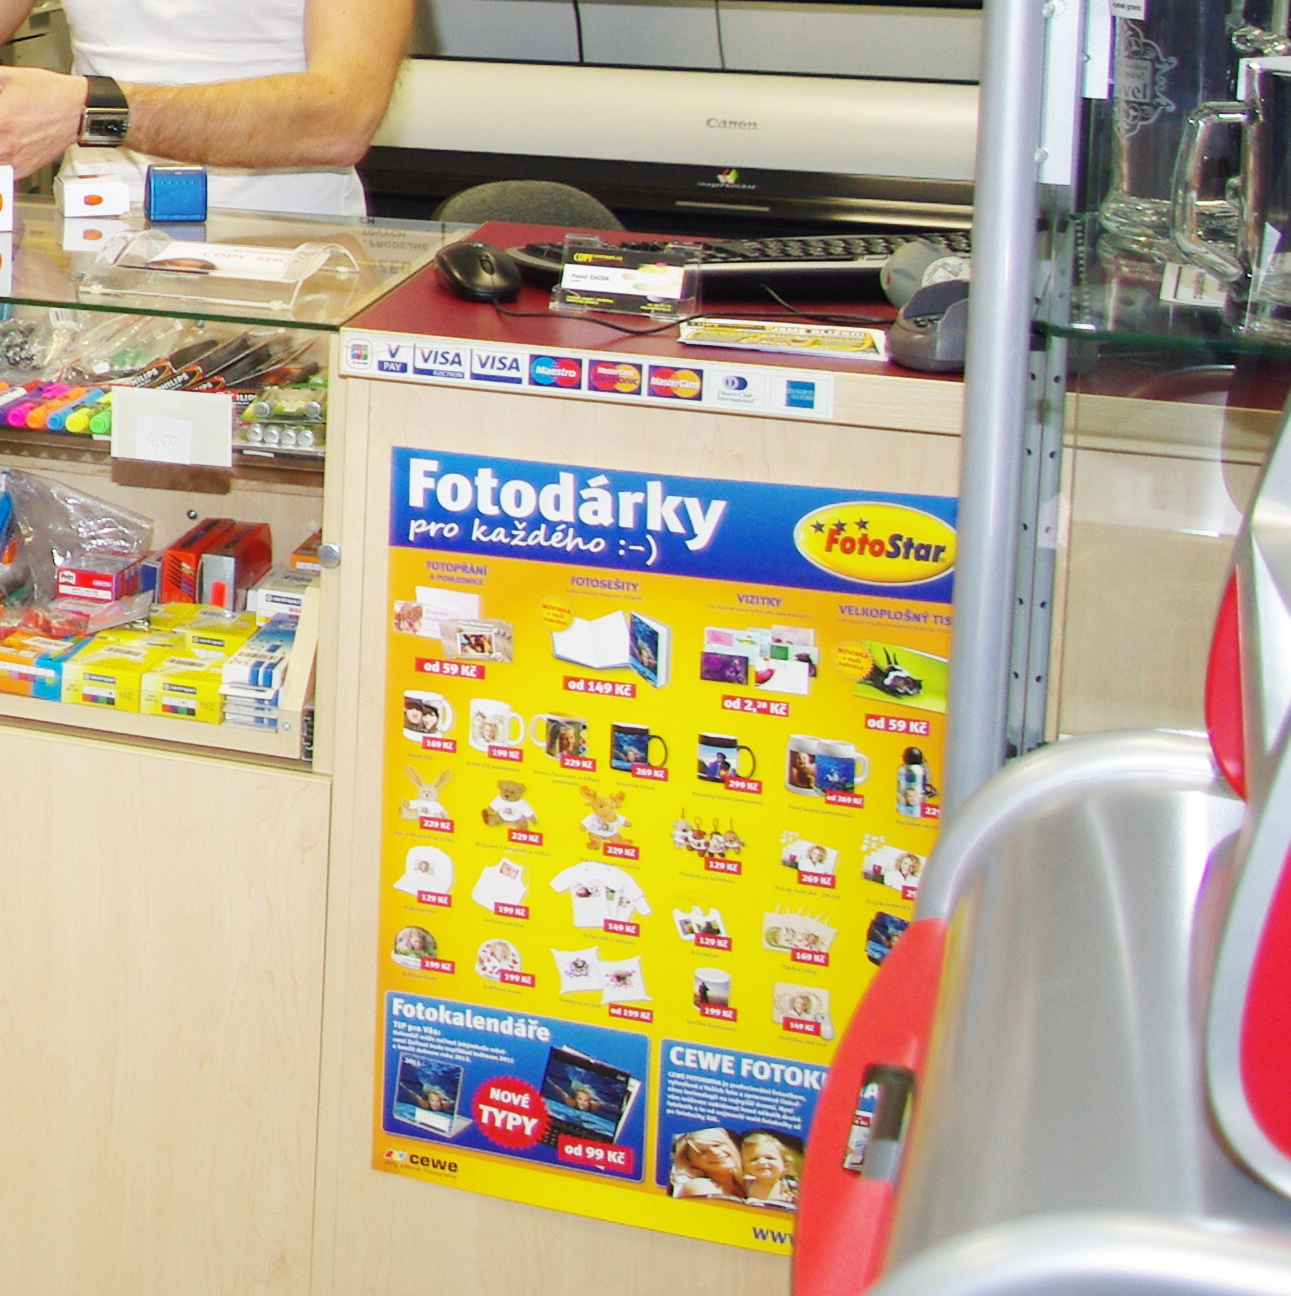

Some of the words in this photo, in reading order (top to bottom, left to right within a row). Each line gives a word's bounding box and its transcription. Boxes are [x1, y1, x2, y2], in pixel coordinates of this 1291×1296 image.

[705, 117, 758, 130] Canon
[420, 348, 463, 366] VISA
[476, 353, 520, 372] VISA
[383, 362, 402, 371] PAY
[535, 364, 577, 379] Maestro
[597, 366, 635, 376] MasterCard
[650, 376, 701, 390] MasterCard
[408, 457, 727, 551] Fotodárky
[408, 518, 459, 542] pro
[471, 517, 606, 554] každého
[824, 528, 947, 563] FotoStar
[426, 560, 488, 576] FOTOPŘÁNÍ
[570, 576, 639, 592] FOTOSEŠITY
[736, 594, 783, 608] VIZITKY
[838, 604, 930, 623] VELKOPLOŠNÝ
[423, 661, 439, 673] od
[442, 662, 458, 675] 59
[460, 664, 477, 678] Kč
[568, 679, 585, 691] od
[587, 680, 612, 694] 149
[614, 683, 632, 697] Kč
[867, 717, 885, 729] od
[888, 719, 906, 731] 59
[909, 721, 927, 734] Kč
[581, 759, 593, 770] Kč
[653, 768, 665, 779] Kč
[745, 781, 758, 792] Kč
[528, 833, 540, 844] Kč
[820, 876, 832, 887] Kč
[515, 907, 526, 918] Kč
[814, 953, 825, 964] Kč
[441, 962, 452, 972] Kč
[521, 975, 532, 985] Kč
[392, 997, 551, 1042] Fotokalendáře
[610, 1006, 621, 1016] od
[640, 1010, 651, 1021] Kč
[669, 1046, 735, 1075] CEWE
[740, 1057, 828, 1090] FOTOK
[489, 1086, 531, 1109] NOVÉ
[478, 1104, 538, 1136] TYPY
[564, 1144, 583, 1157] od
[585, 1147, 605, 1161] 99
[607, 1150, 626, 1165] Kč
[409, 1154, 459, 1173] cewe
